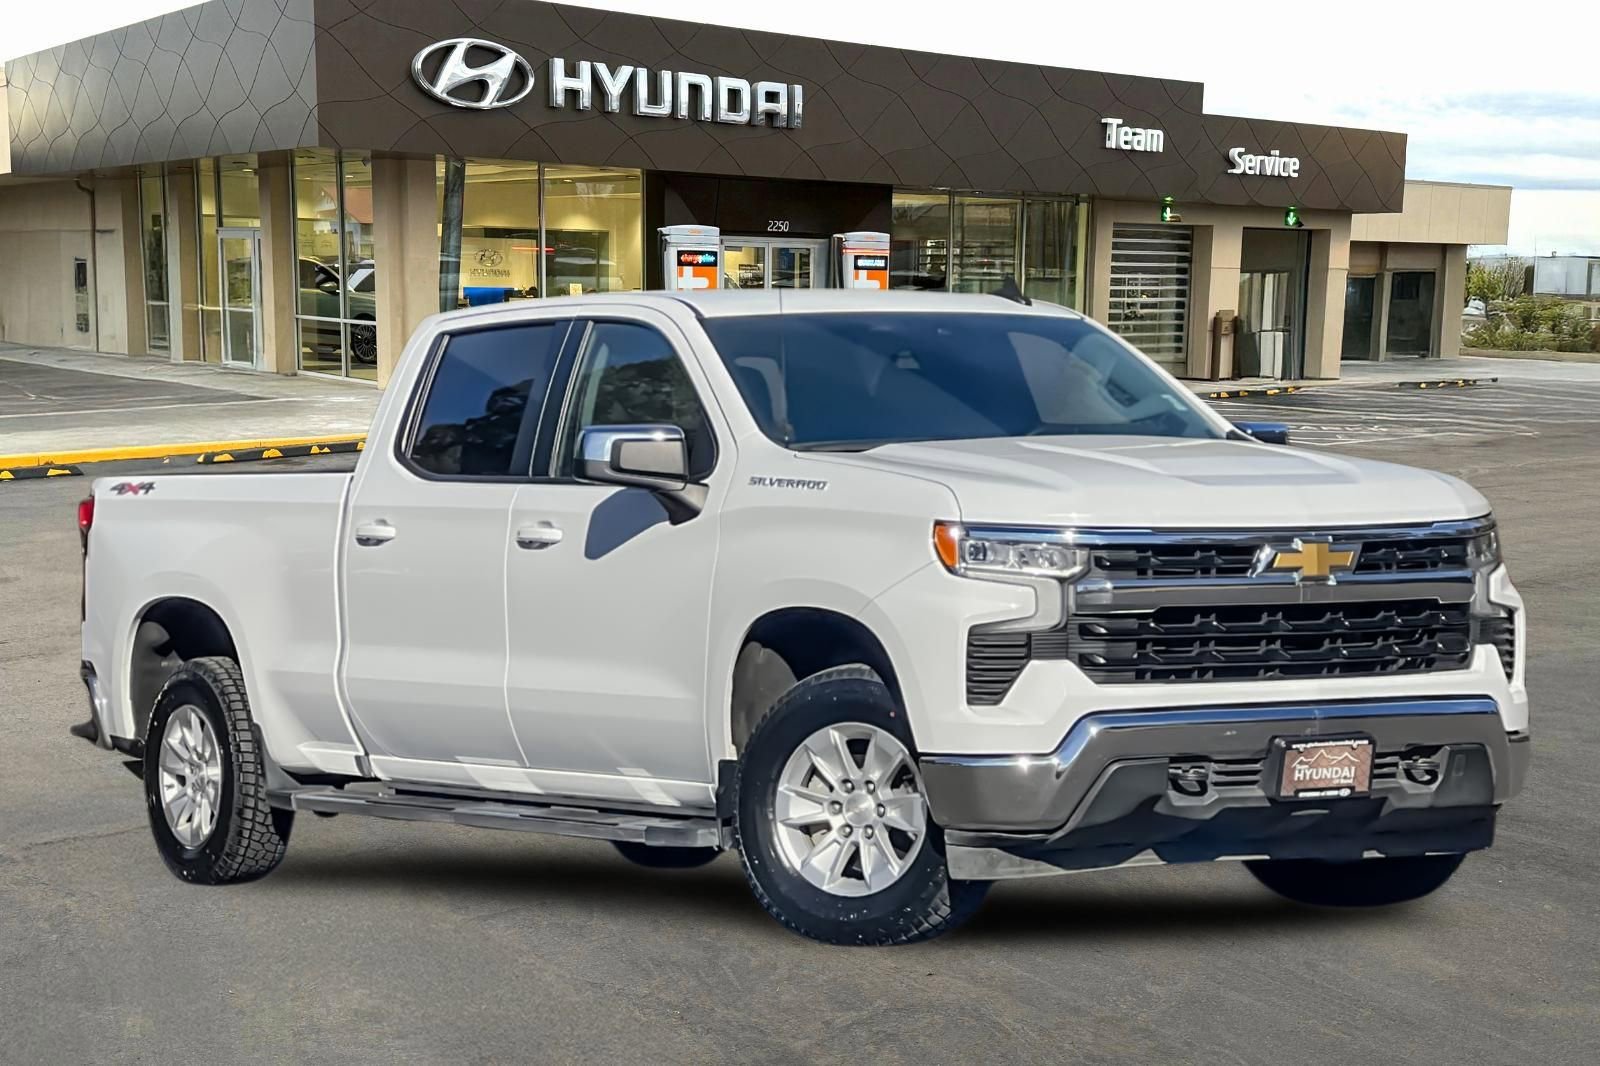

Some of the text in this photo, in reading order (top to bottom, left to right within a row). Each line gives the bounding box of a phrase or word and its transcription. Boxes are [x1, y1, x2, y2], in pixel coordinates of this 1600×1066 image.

[549, 57, 803, 129] HYUNDAI
[1101, 117, 1164, 153] Team
[1227, 147, 1300, 178] Service
[767, 220, 790, 232] 2250
[748, 475, 828, 491] SILVERADO
[1294, 766, 1356, 781] HYUNDAI
